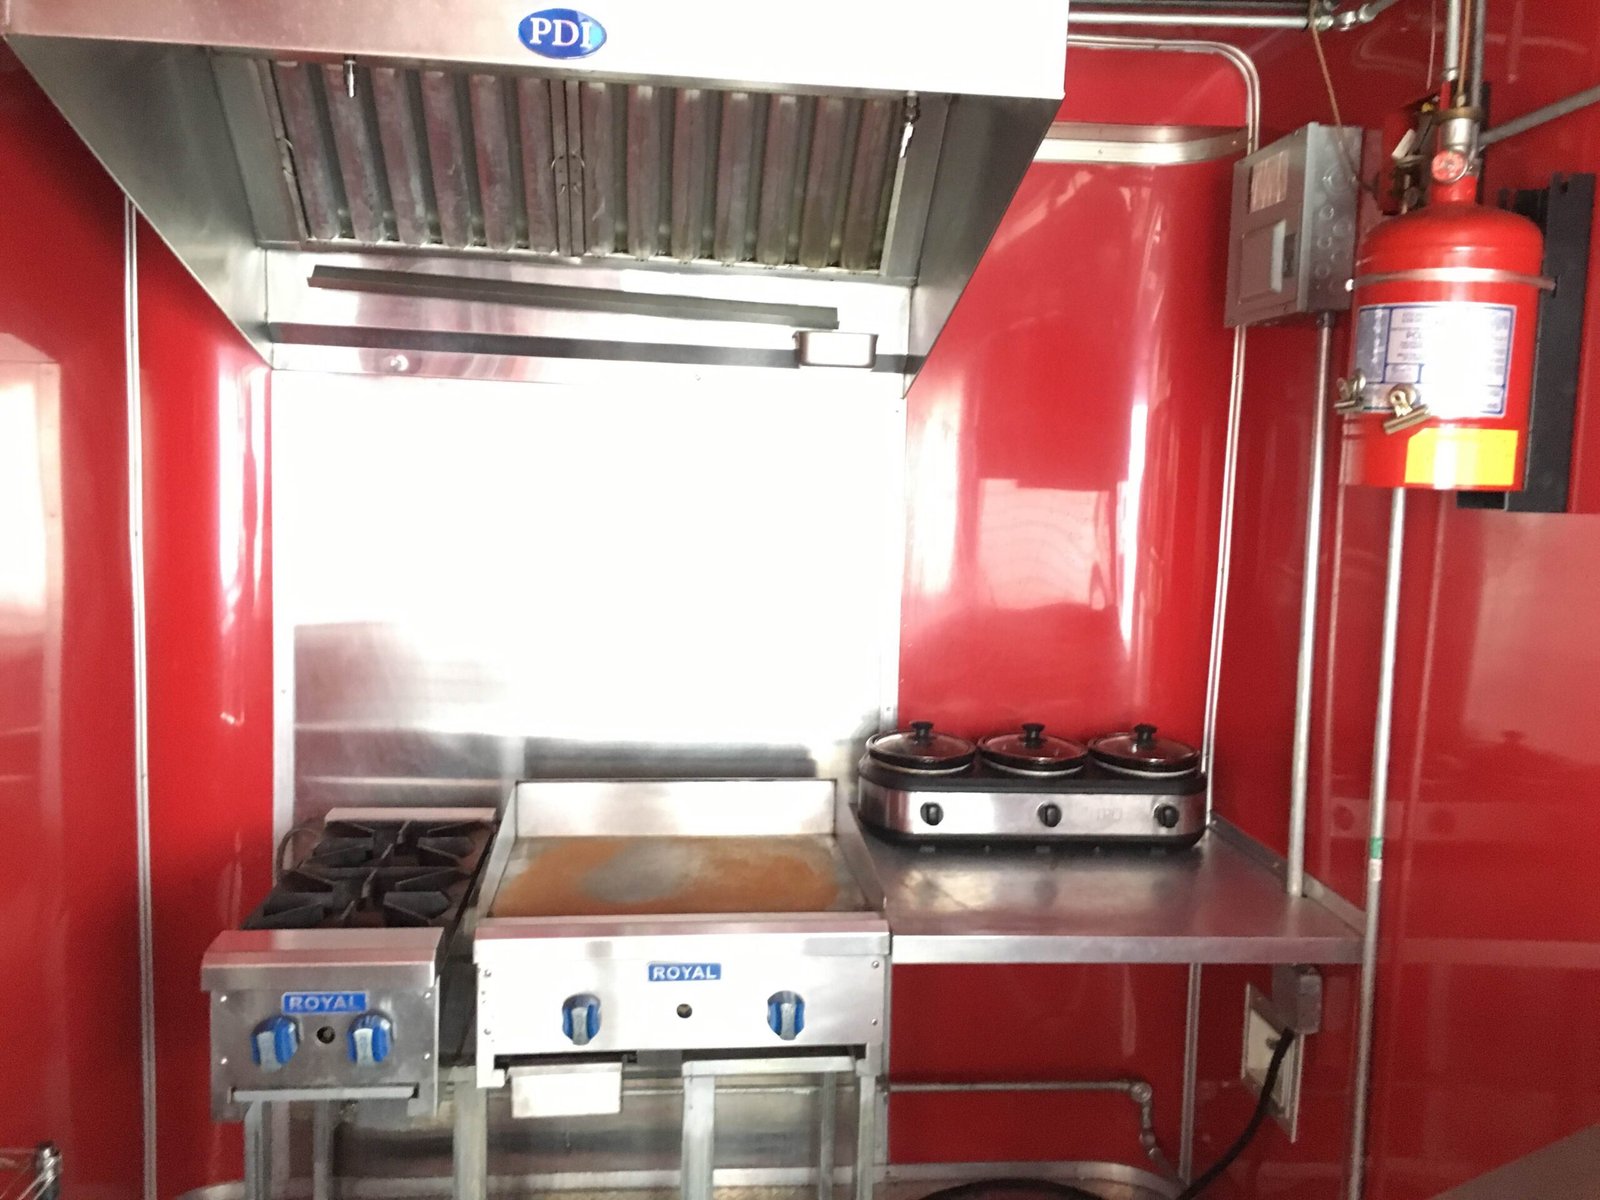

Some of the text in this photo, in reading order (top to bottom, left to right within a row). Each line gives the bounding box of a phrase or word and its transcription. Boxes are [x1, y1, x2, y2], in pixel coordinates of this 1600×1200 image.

[529, 17, 593, 49] PDI
[653, 966, 717, 980] ROYAL
[289, 995, 358, 1011] ROYAL
